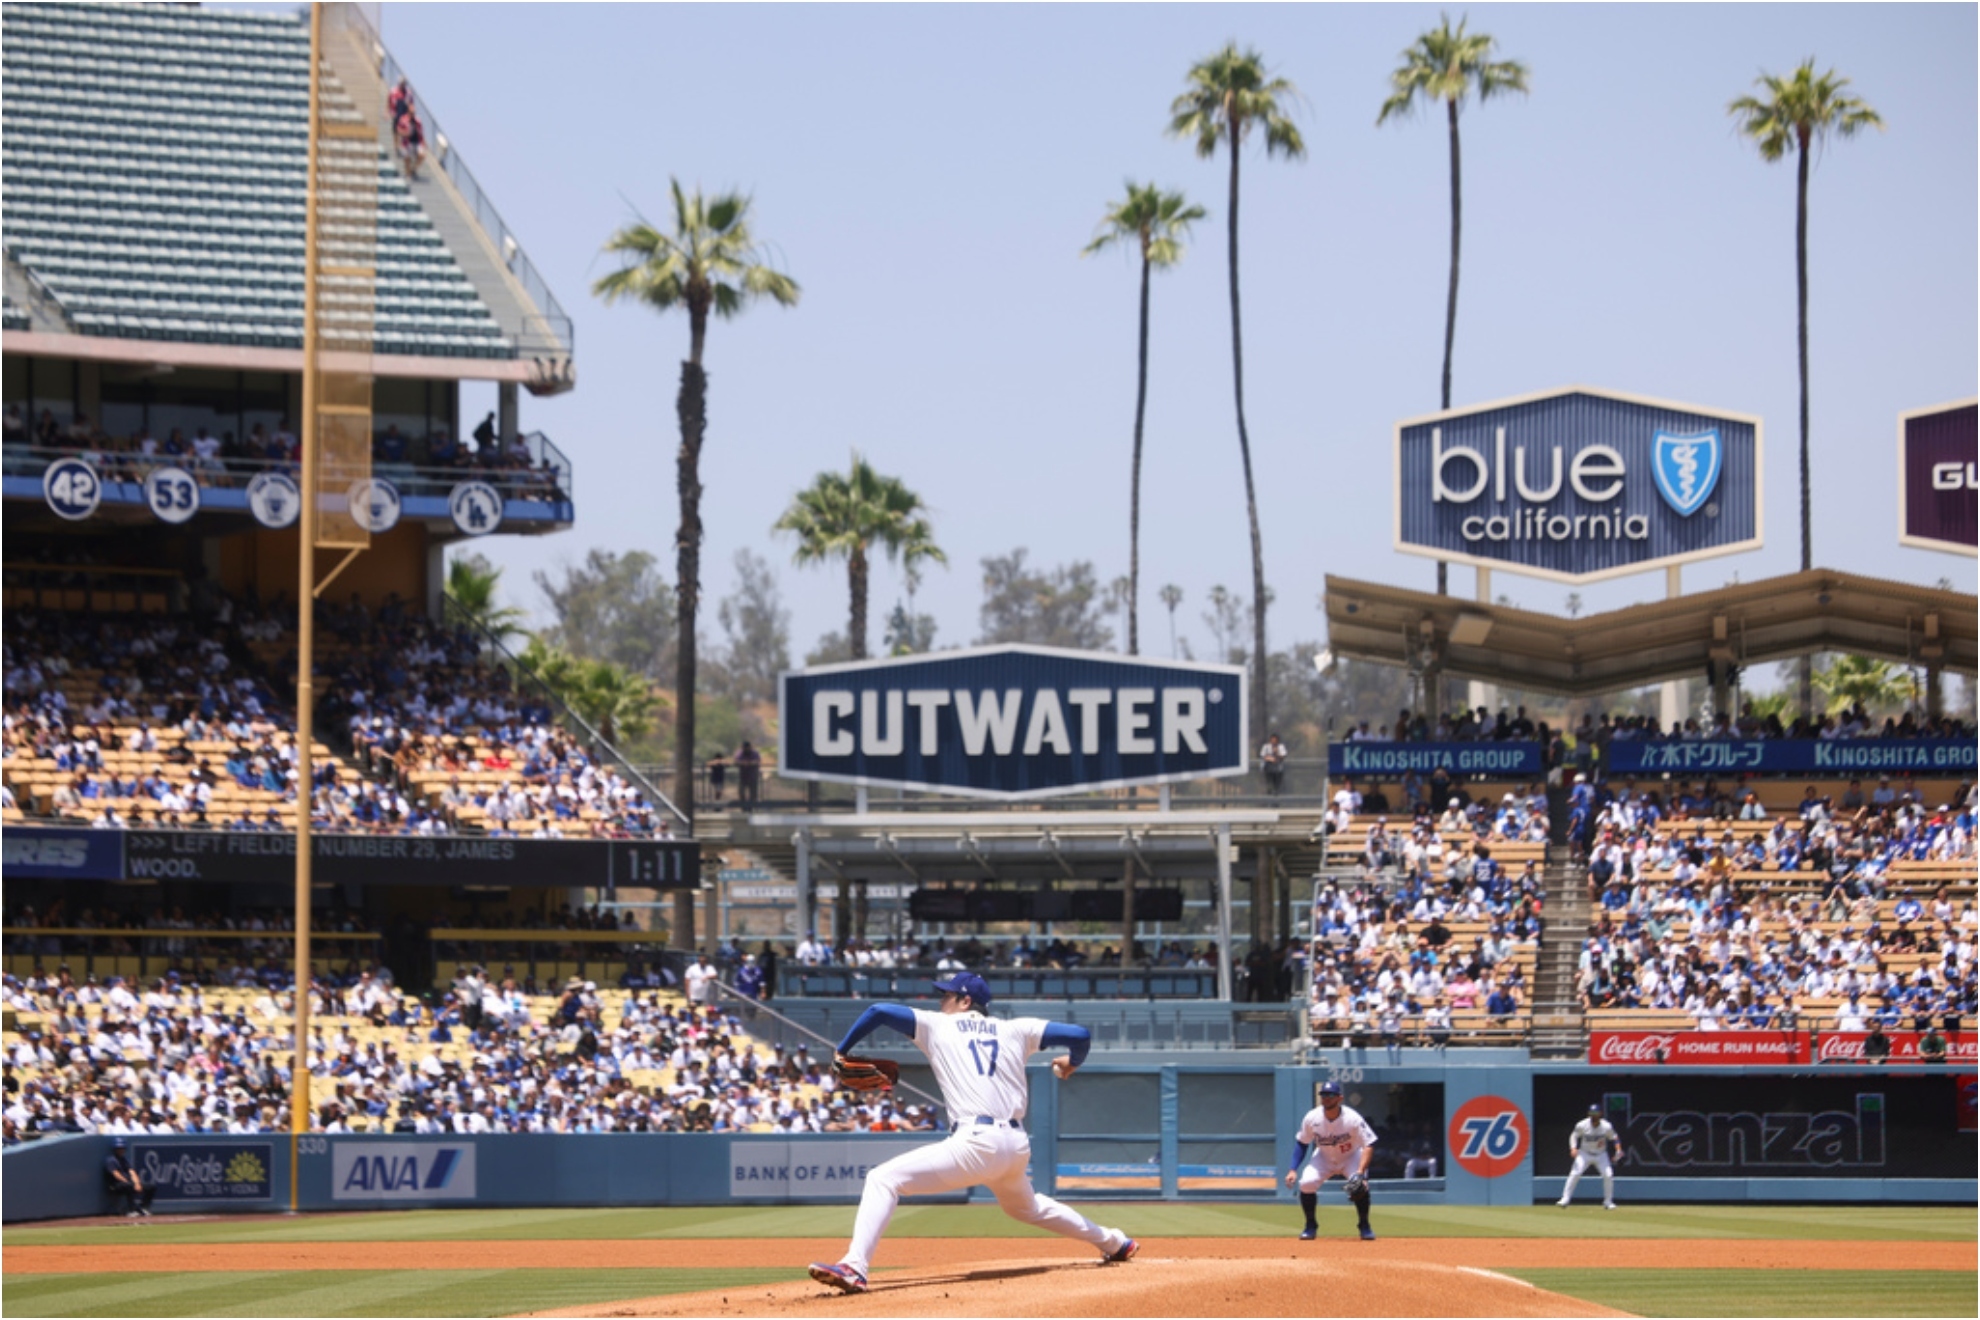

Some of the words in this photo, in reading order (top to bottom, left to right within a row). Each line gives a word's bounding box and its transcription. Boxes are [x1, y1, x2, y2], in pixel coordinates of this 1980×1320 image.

[1432, 427, 1626, 502] blue
[51, 471, 94, 505] 42
[154, 479, 193, 510] 53
[1461, 507, 1649, 541] california
[812, 687, 1208, 756] CUTWATER
[1343, 747, 1451, 769] KINOSHITA
[1459, 749, 1525, 769] GROUP
[1815, 743, 1927, 766] KINOSHITA
[1933, 746, 1978, 766] GRO
[171, 834, 223, 853] LEFT
[227, 835, 296, 855] FIELDE
[318, 836, 407, 857] NUMBER
[413, 840, 440, 860] 29,
[445, 840, 515, 860] JAMES
[130, 857, 202, 878] WOOD.
[628, 850, 683, 881] 1:11
[968, 1038, 998, 1076] 17
[1678, 1042, 1719, 1053] HOME
[1723, 1042, 1752, 1053] RUN
[1329, 1067, 1363, 1082] 360
[299, 1138, 327, 1154] 330
[1458, 1110, 1520, 1160] 76
[140, 1150, 223, 1187] Surfside
[343, 1155, 419, 1191] ANA
[735, 1166, 790, 1181] BANK
[795, 1166, 819, 1180] OF
[825, 1164, 877, 1180] AME
